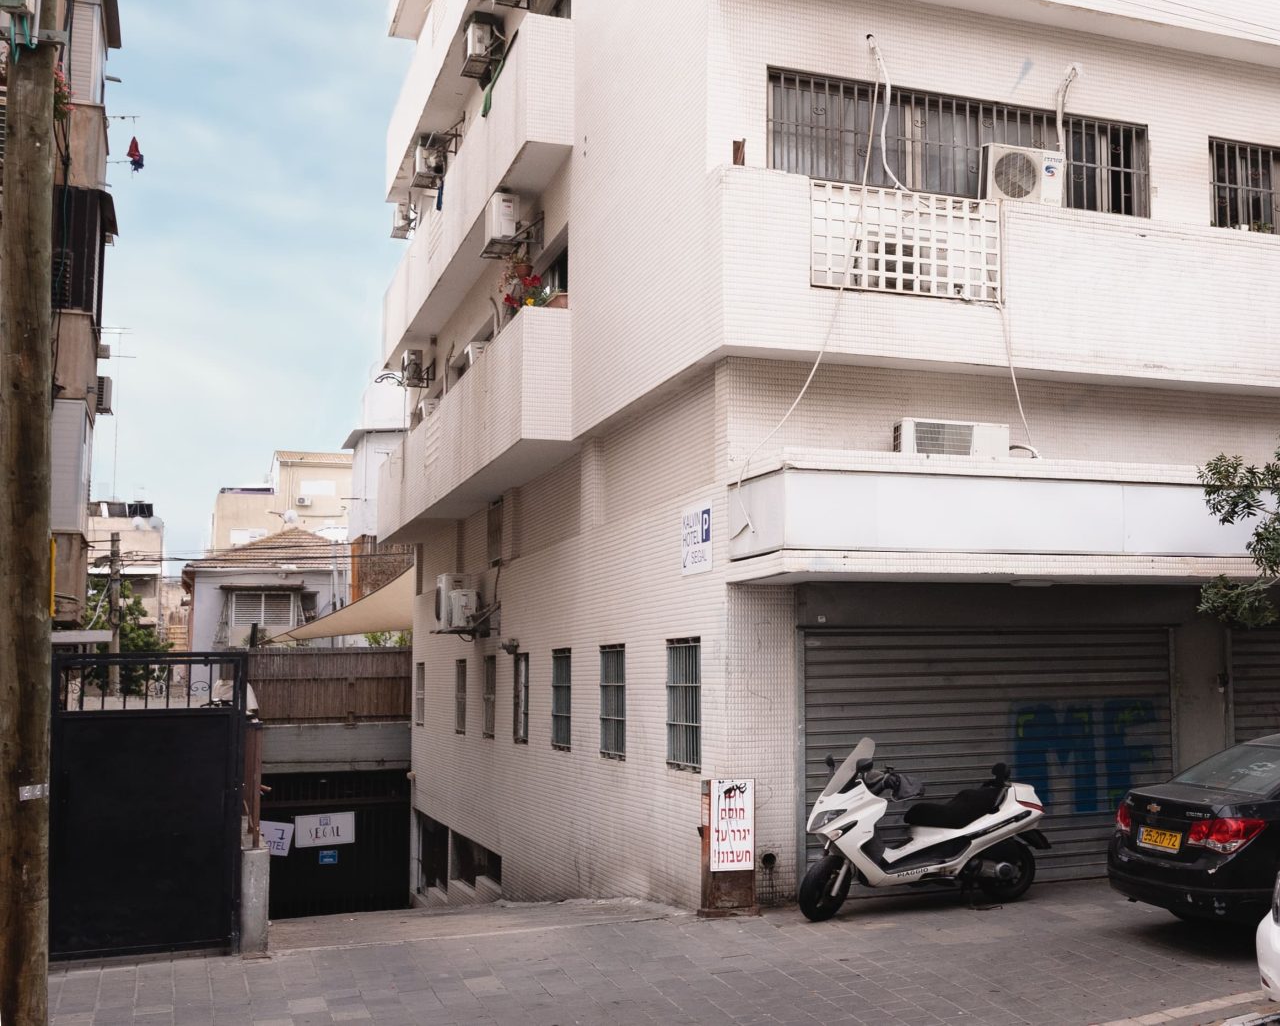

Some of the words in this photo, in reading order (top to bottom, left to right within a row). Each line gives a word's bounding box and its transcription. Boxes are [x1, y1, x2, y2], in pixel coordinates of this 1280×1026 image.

[703, 514, 709, 540] P
[683, 530, 700, 548] HOTEL
[720, 807, 745, 820] חוסם
[714, 827, 727, 842] על
[730, 828, 750, 842] יגרר
[266, 840, 286, 851] OTEL
[896, 867, 929, 878] PIAGGIO
